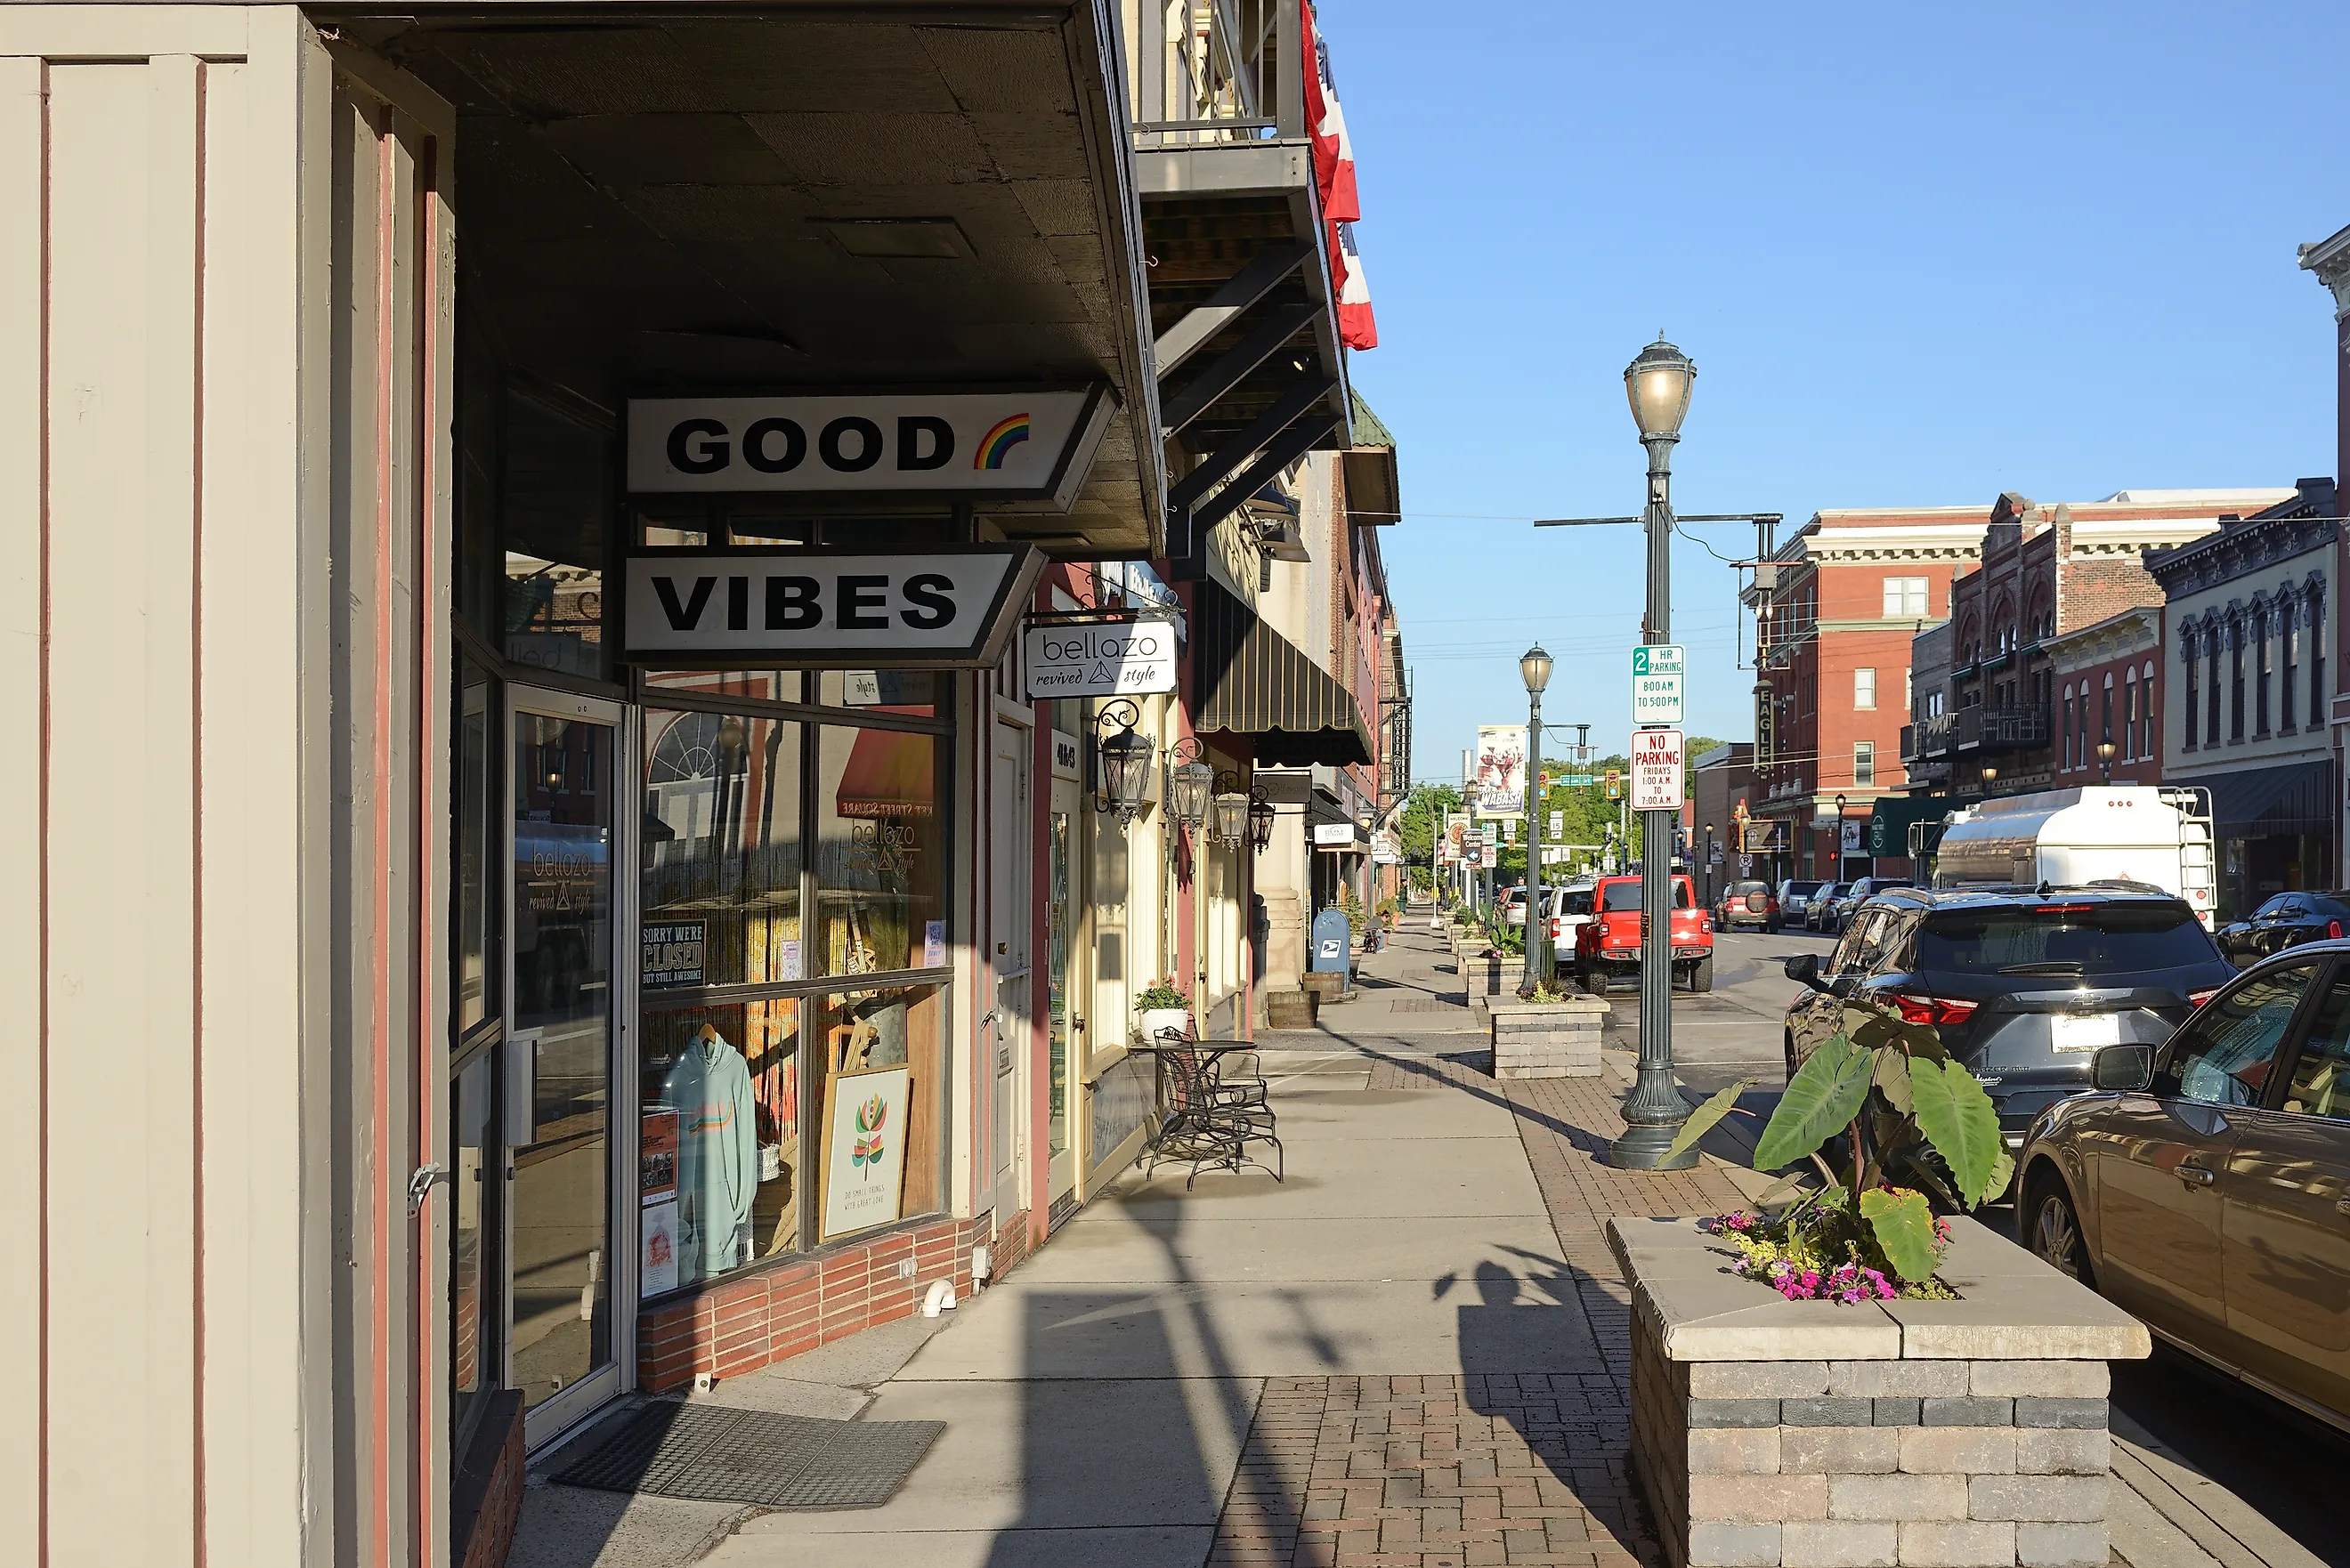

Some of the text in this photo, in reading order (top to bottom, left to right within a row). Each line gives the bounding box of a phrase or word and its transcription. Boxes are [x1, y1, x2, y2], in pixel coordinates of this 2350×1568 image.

[666, 416, 955, 474] GOOD
[650, 573, 957, 632] VIBES
[1042, 632, 1157, 660] bellazo
[1635, 651, 1673, 672] 2 HR
[1649, 662, 1681, 672] PARKING
[1035, 665, 1155, 686] revived style
[1638, 697, 1648, 707] TO
[1760, 690, 1771, 772] EAGLES
[1650, 735, 1665, 749] NO
[1635, 751, 1679, 765] PARKING
[1643, 767, 1671, 775] FRIDAYS
[1642, 777, 1656, 785] 1:00
[1481, 791, 1522, 806] WABASH
[1641, 796, 1657, 804] 7:00
[533, 843, 590, 877] bellazo
[529, 889, 590, 915] revived style
[643, 927, 673, 942] SORRY
[643, 942, 703, 973] CLOSED
[643, 970, 701, 983] BUT STILL AWESOME
